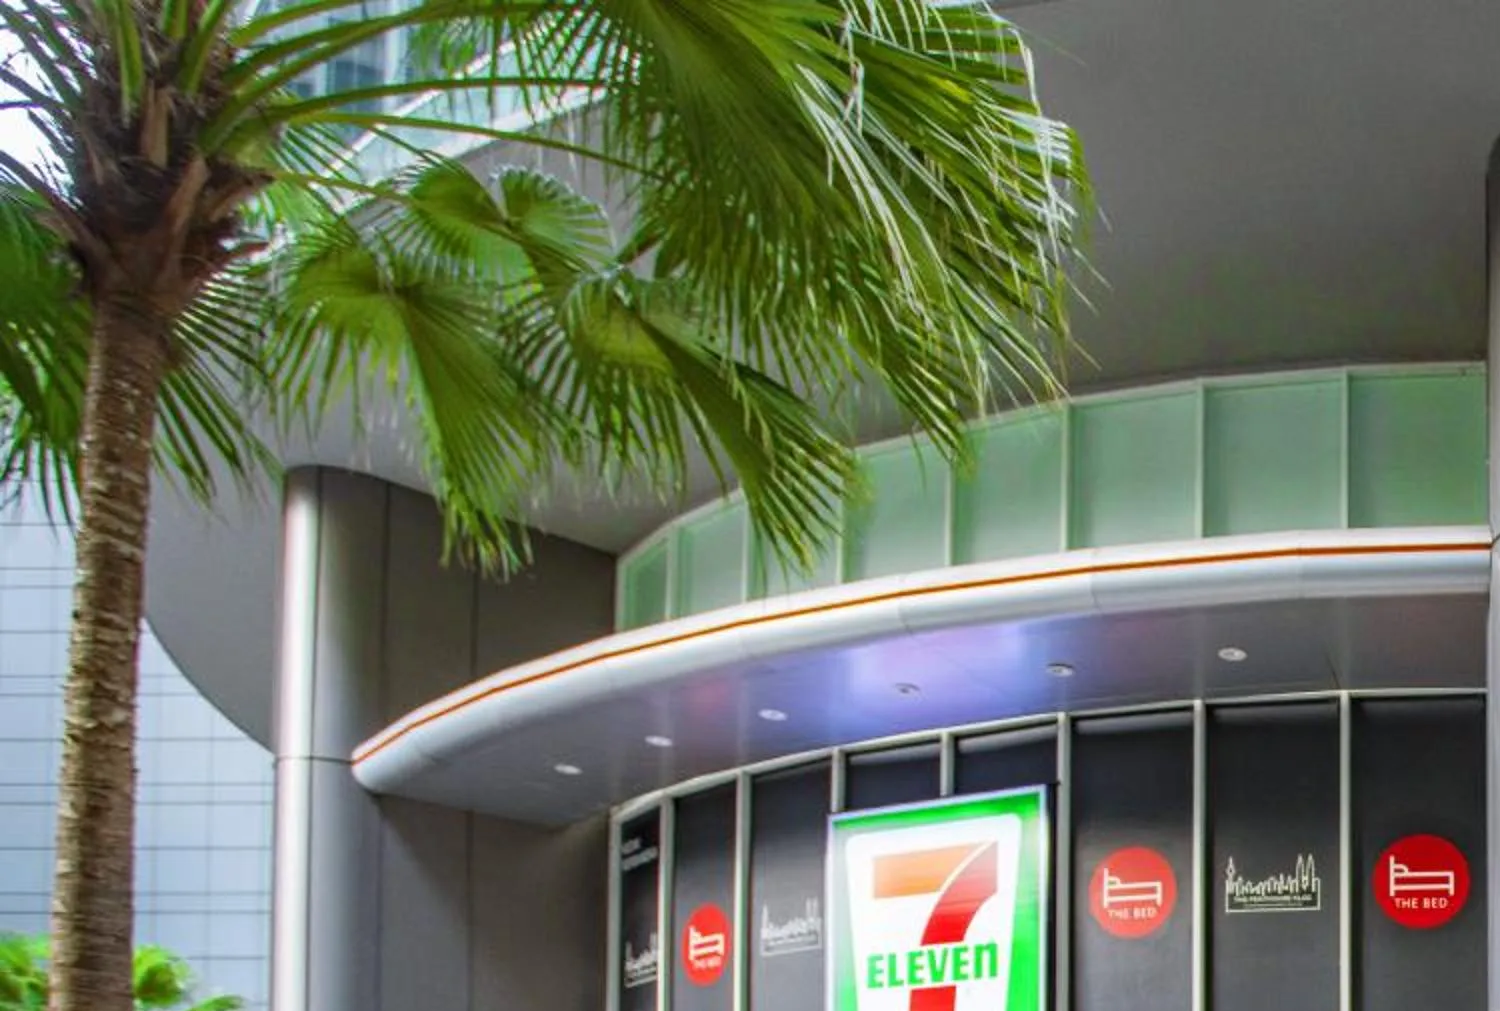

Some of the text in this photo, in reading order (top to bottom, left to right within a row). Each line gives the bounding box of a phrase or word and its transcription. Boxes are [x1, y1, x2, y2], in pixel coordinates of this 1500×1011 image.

[1395, 897, 1449, 909] THE BED
[1108, 907, 1157, 920] THE BED
